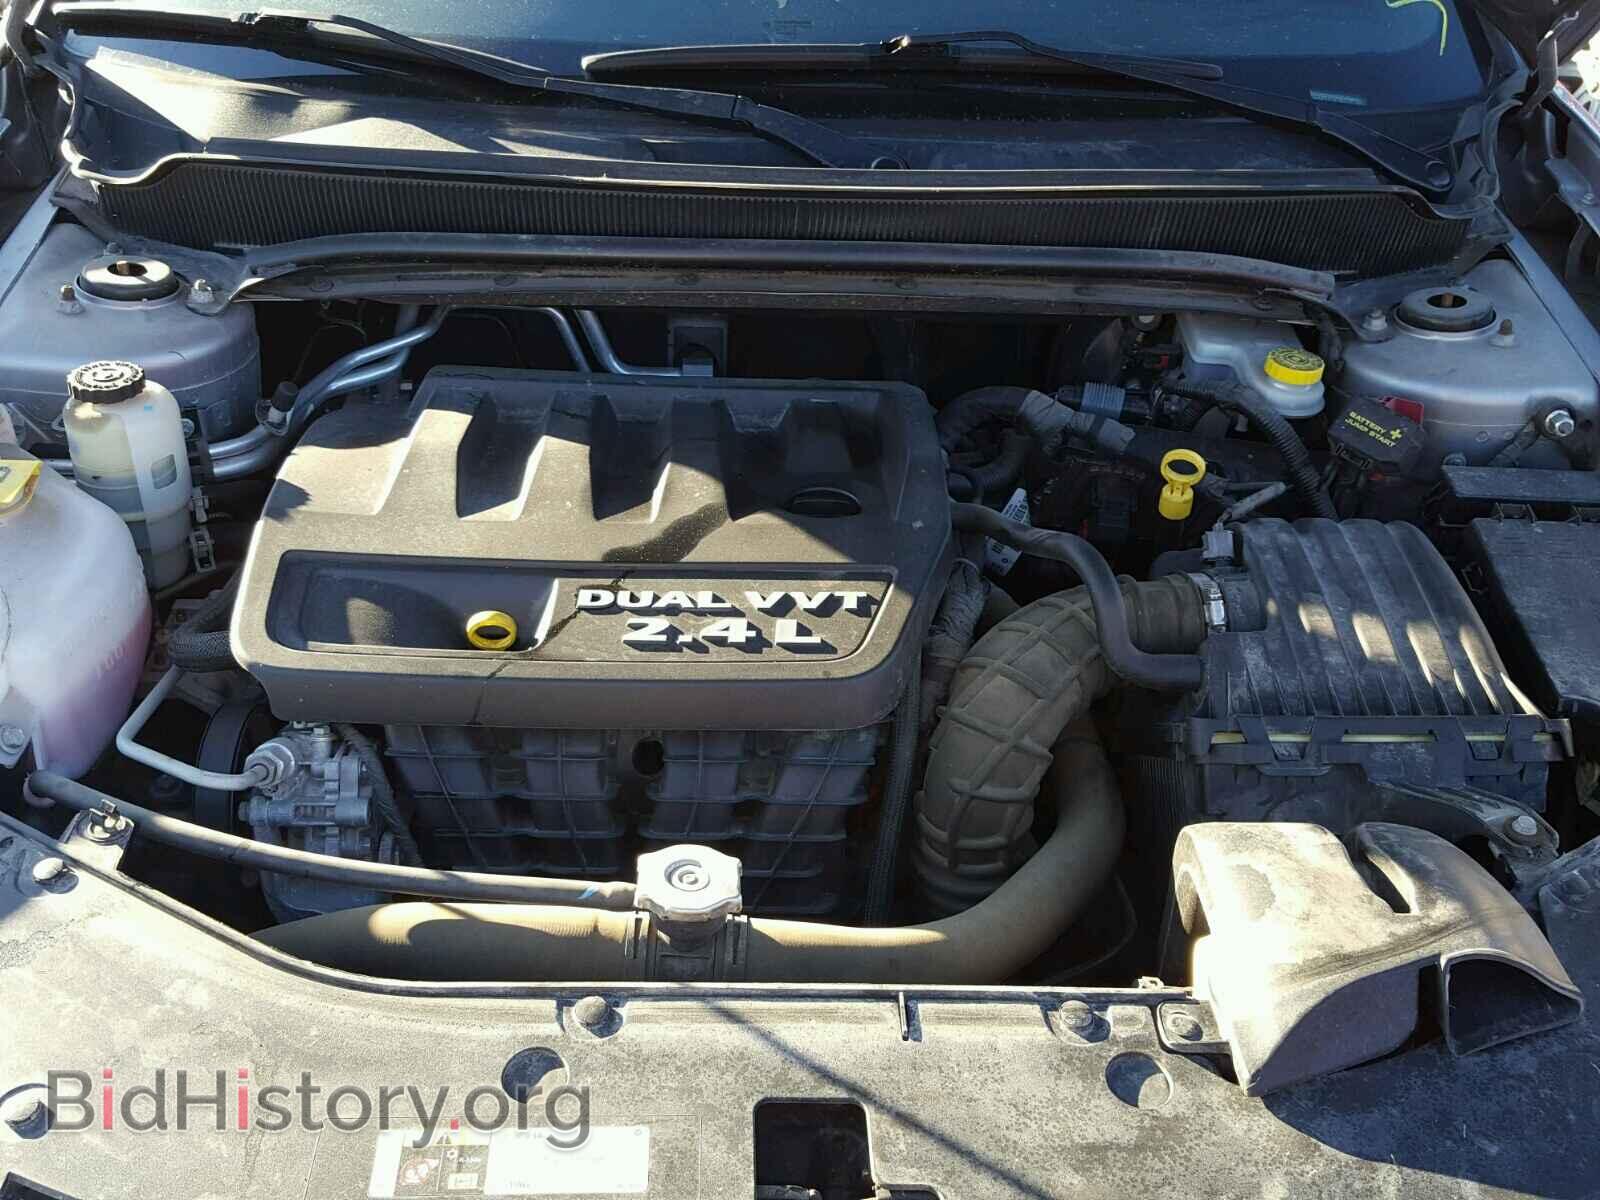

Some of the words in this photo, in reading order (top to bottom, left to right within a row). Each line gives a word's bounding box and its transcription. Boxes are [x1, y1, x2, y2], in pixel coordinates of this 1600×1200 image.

[1344, 418, 1369, 433] JUMP
[1368, 430, 1397, 448] START
[1348, 411, 1387, 435] BATTERY
[576, 589, 737, 611] DUAL
[744, 591, 870, 612] VVT
